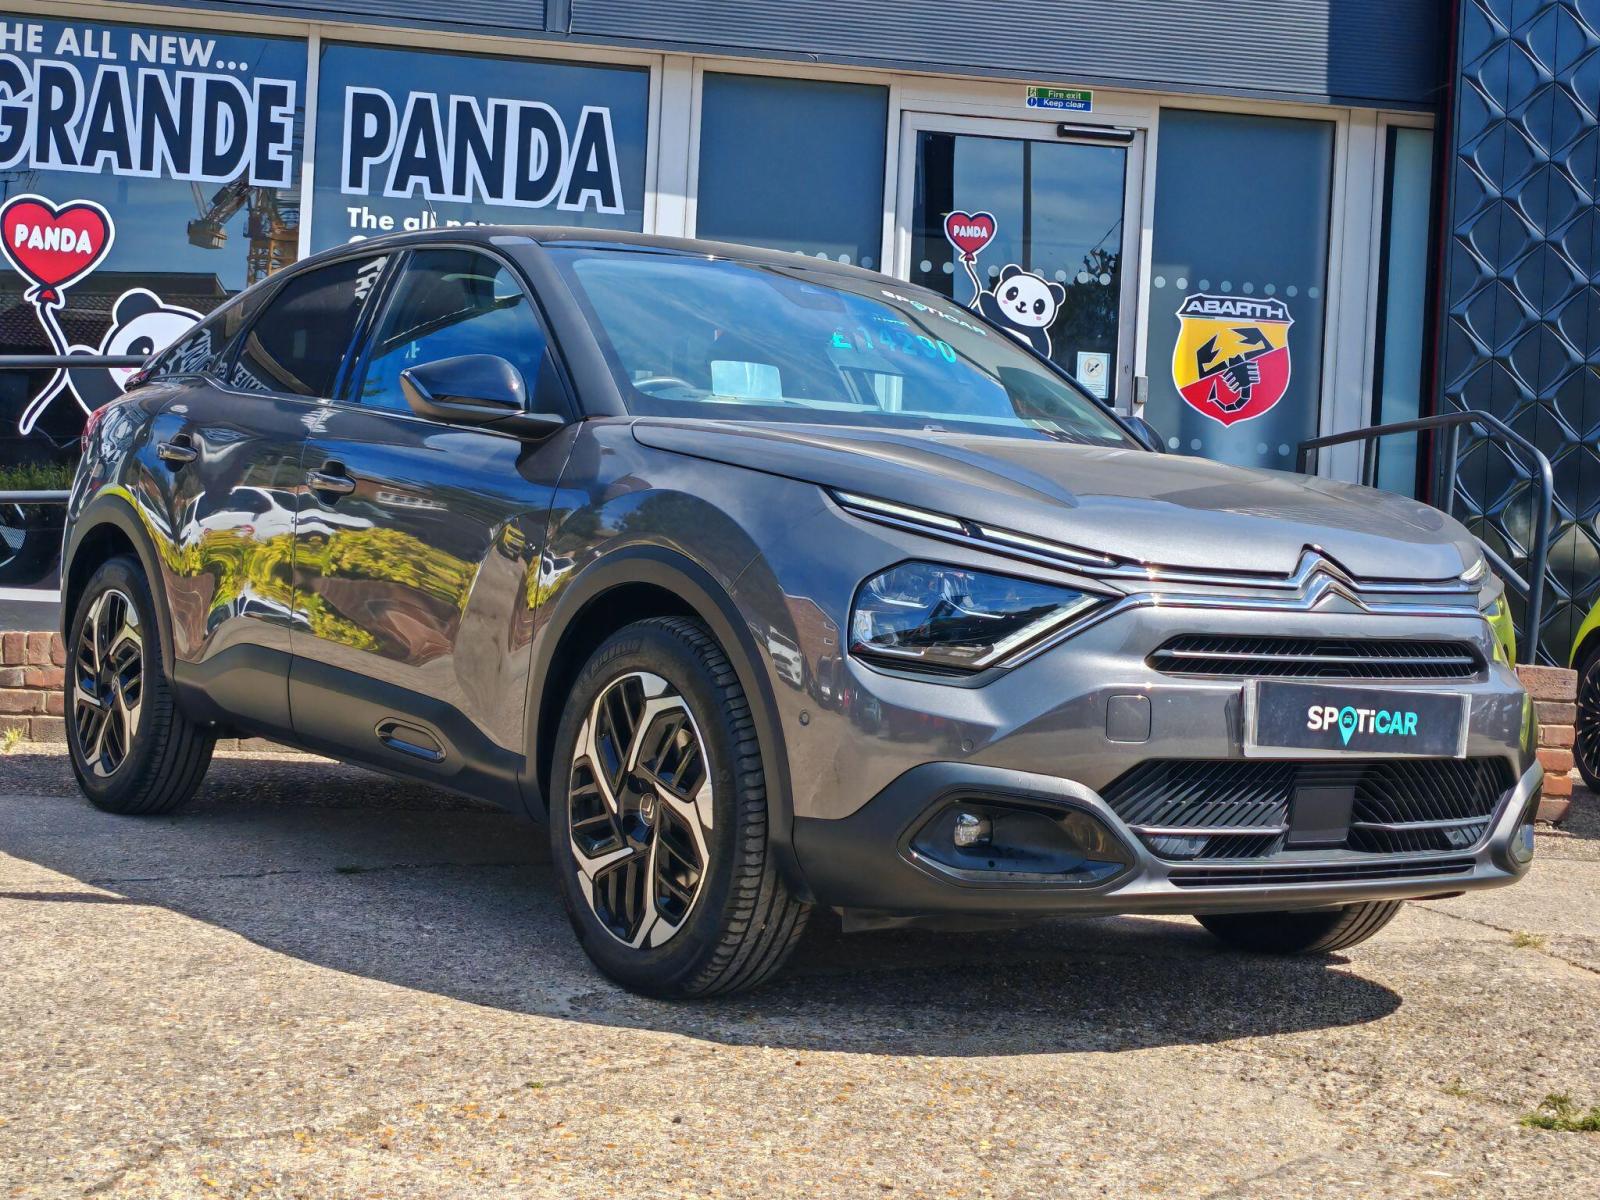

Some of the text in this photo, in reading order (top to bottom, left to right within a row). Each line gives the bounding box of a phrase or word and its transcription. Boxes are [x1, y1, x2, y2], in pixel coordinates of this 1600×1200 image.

[0, 21, 249, 71] HE ALL NEW...
[1043, 98, 1085, 109] Keep clear
[1048, 90, 1082, 100] Fire exit
[341, 85, 625, 215] PANDA
[347, 206, 437, 231] The all
[14, 223, 92, 255] PANDA
[953, 224, 988, 238] PANDA
[1186, 300, 1283, 319] ABARTH
